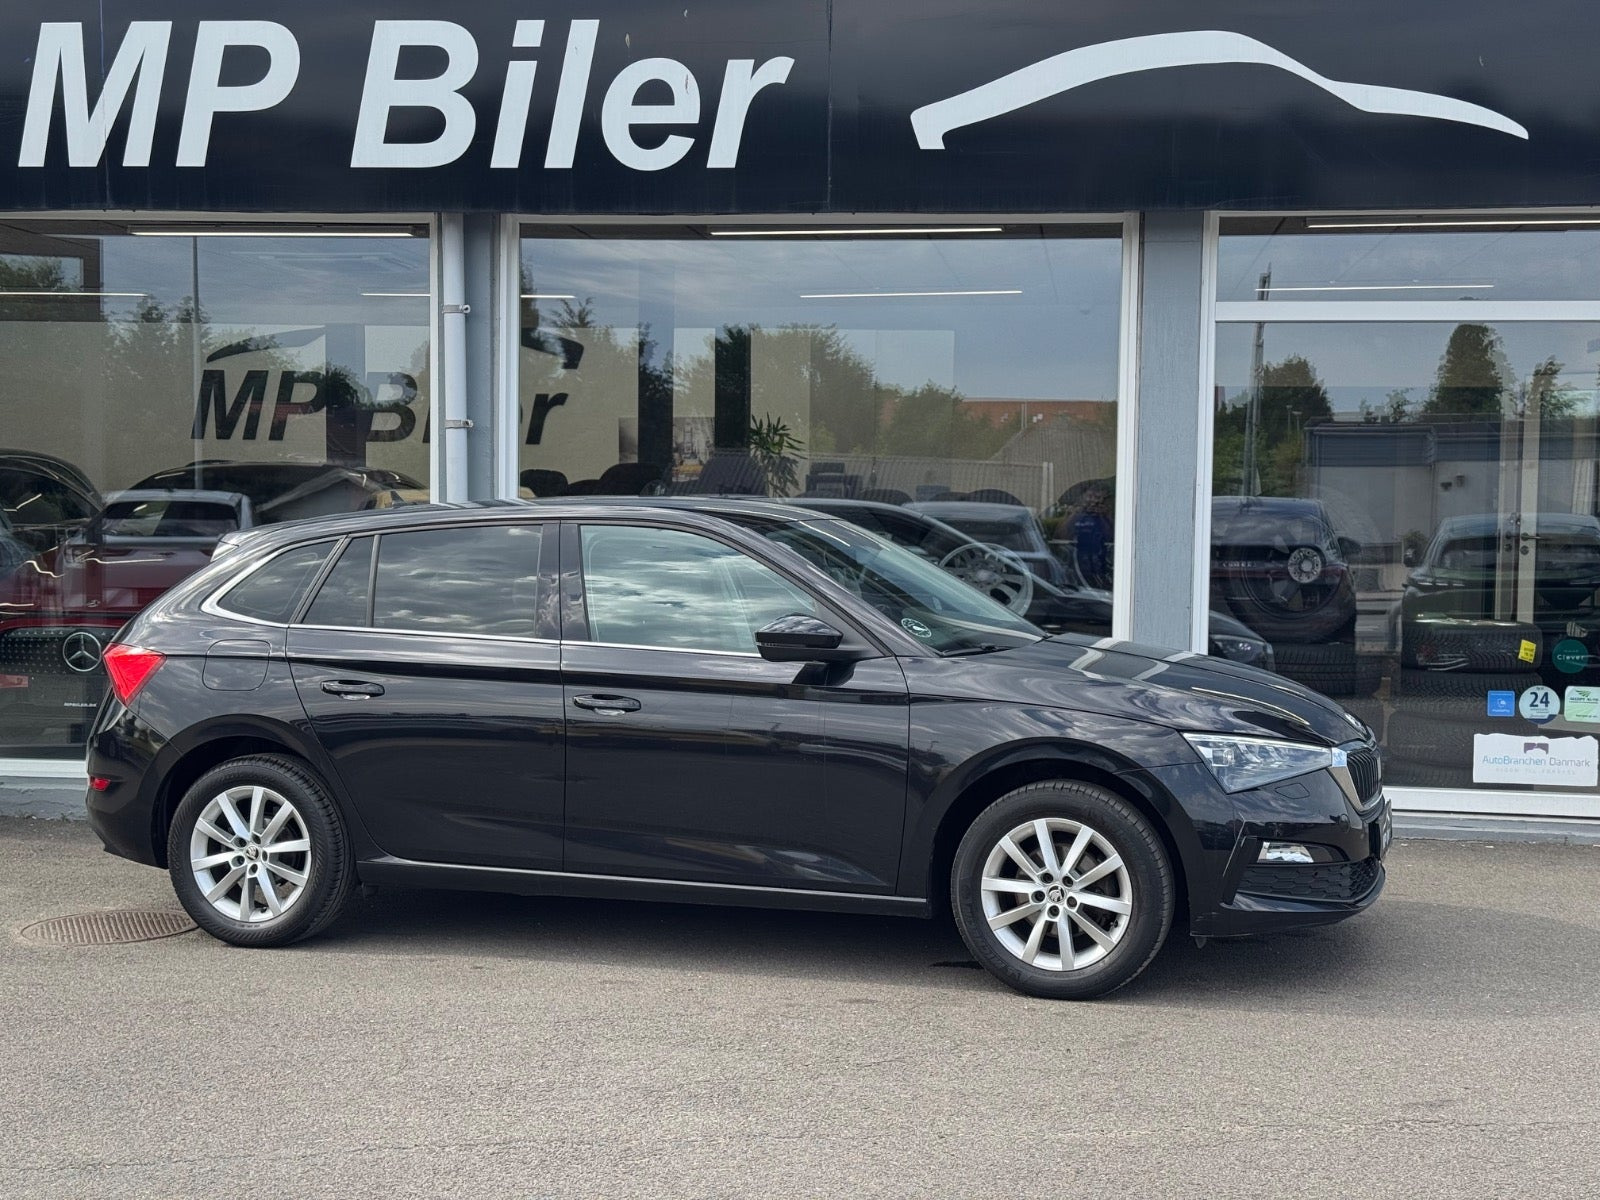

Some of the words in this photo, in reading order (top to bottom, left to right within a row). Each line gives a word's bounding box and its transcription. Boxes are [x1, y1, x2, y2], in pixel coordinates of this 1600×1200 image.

[18, 21, 300, 167] MP
[351, 20, 795, 171] Biler
[190, 369, 327, 441] MP
[1556, 653, 1585, 661] Clever
[1529, 691, 1550, 708] 24
[1482, 754, 1547, 767] AutoBranchen
[1549, 756, 1591, 769] Danmark
